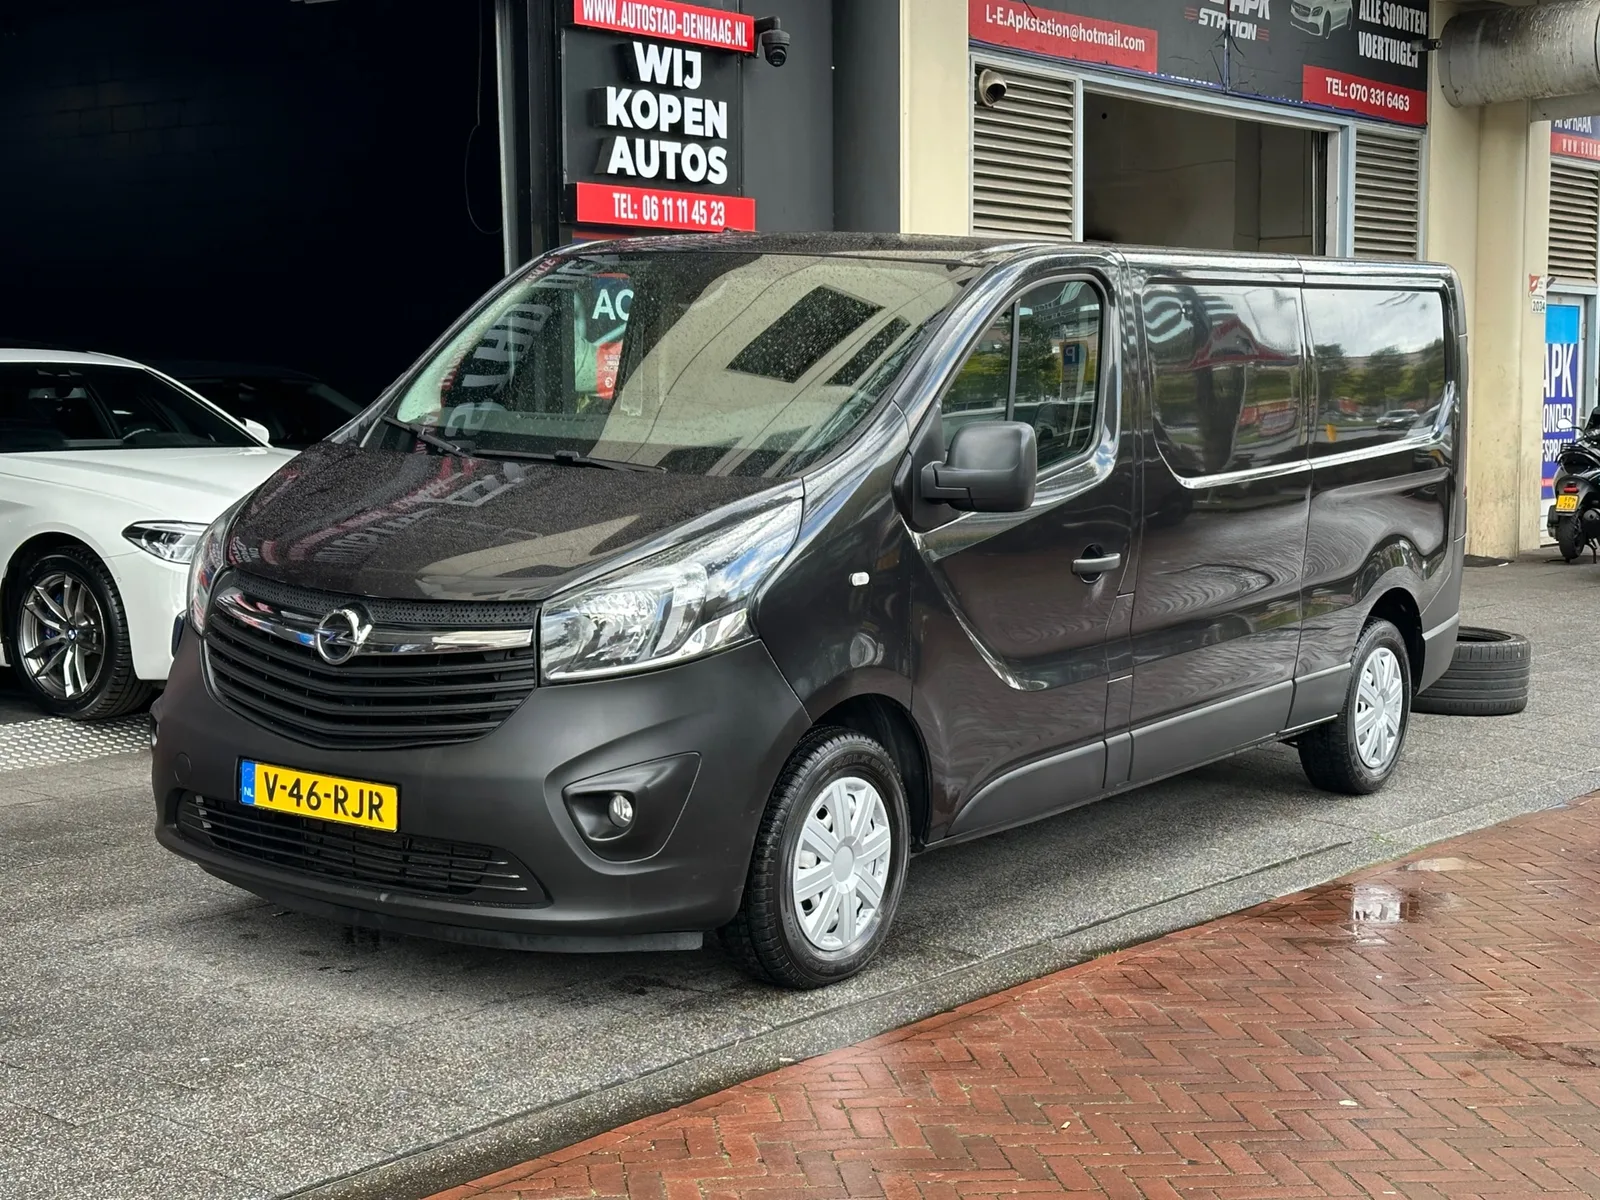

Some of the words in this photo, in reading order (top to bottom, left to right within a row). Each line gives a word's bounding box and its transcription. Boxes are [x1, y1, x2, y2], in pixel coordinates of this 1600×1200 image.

[583, 0, 748, 47] WWW.AUTOSTAD-DENHAAG.NL
[985, 4, 1146, 52] L-E.Apkstation@hotmail.com
[1198, 7, 1257, 41] STATION
[1358, 0, 1381, 24] ALLE
[1382, 1, 1427, 35] SOORTEN
[633, 41, 702, 90] WIJ
[1358, 31, 1419, 68] VOERTUIGEN
[606, 86, 728, 139] KOPEN
[1326, 77, 1348, 98] TEL:
[1349, 82, 1368, 103] 070
[1369, 86, 1385, 107] 331
[1386, 90, 1410, 112] 6463
[607, 136, 728, 185] AUTOS
[612, 192, 638, 220] TEL:
[642, 194, 659, 221] 06
[662, 196, 673, 222] 11
[677, 198, 688, 223] 11
[691, 198, 707, 225] 45
[710, 201, 725, 226] 23
[244, 786, 254, 797] NL
[263, 771, 384, 822] V-46-RJR
